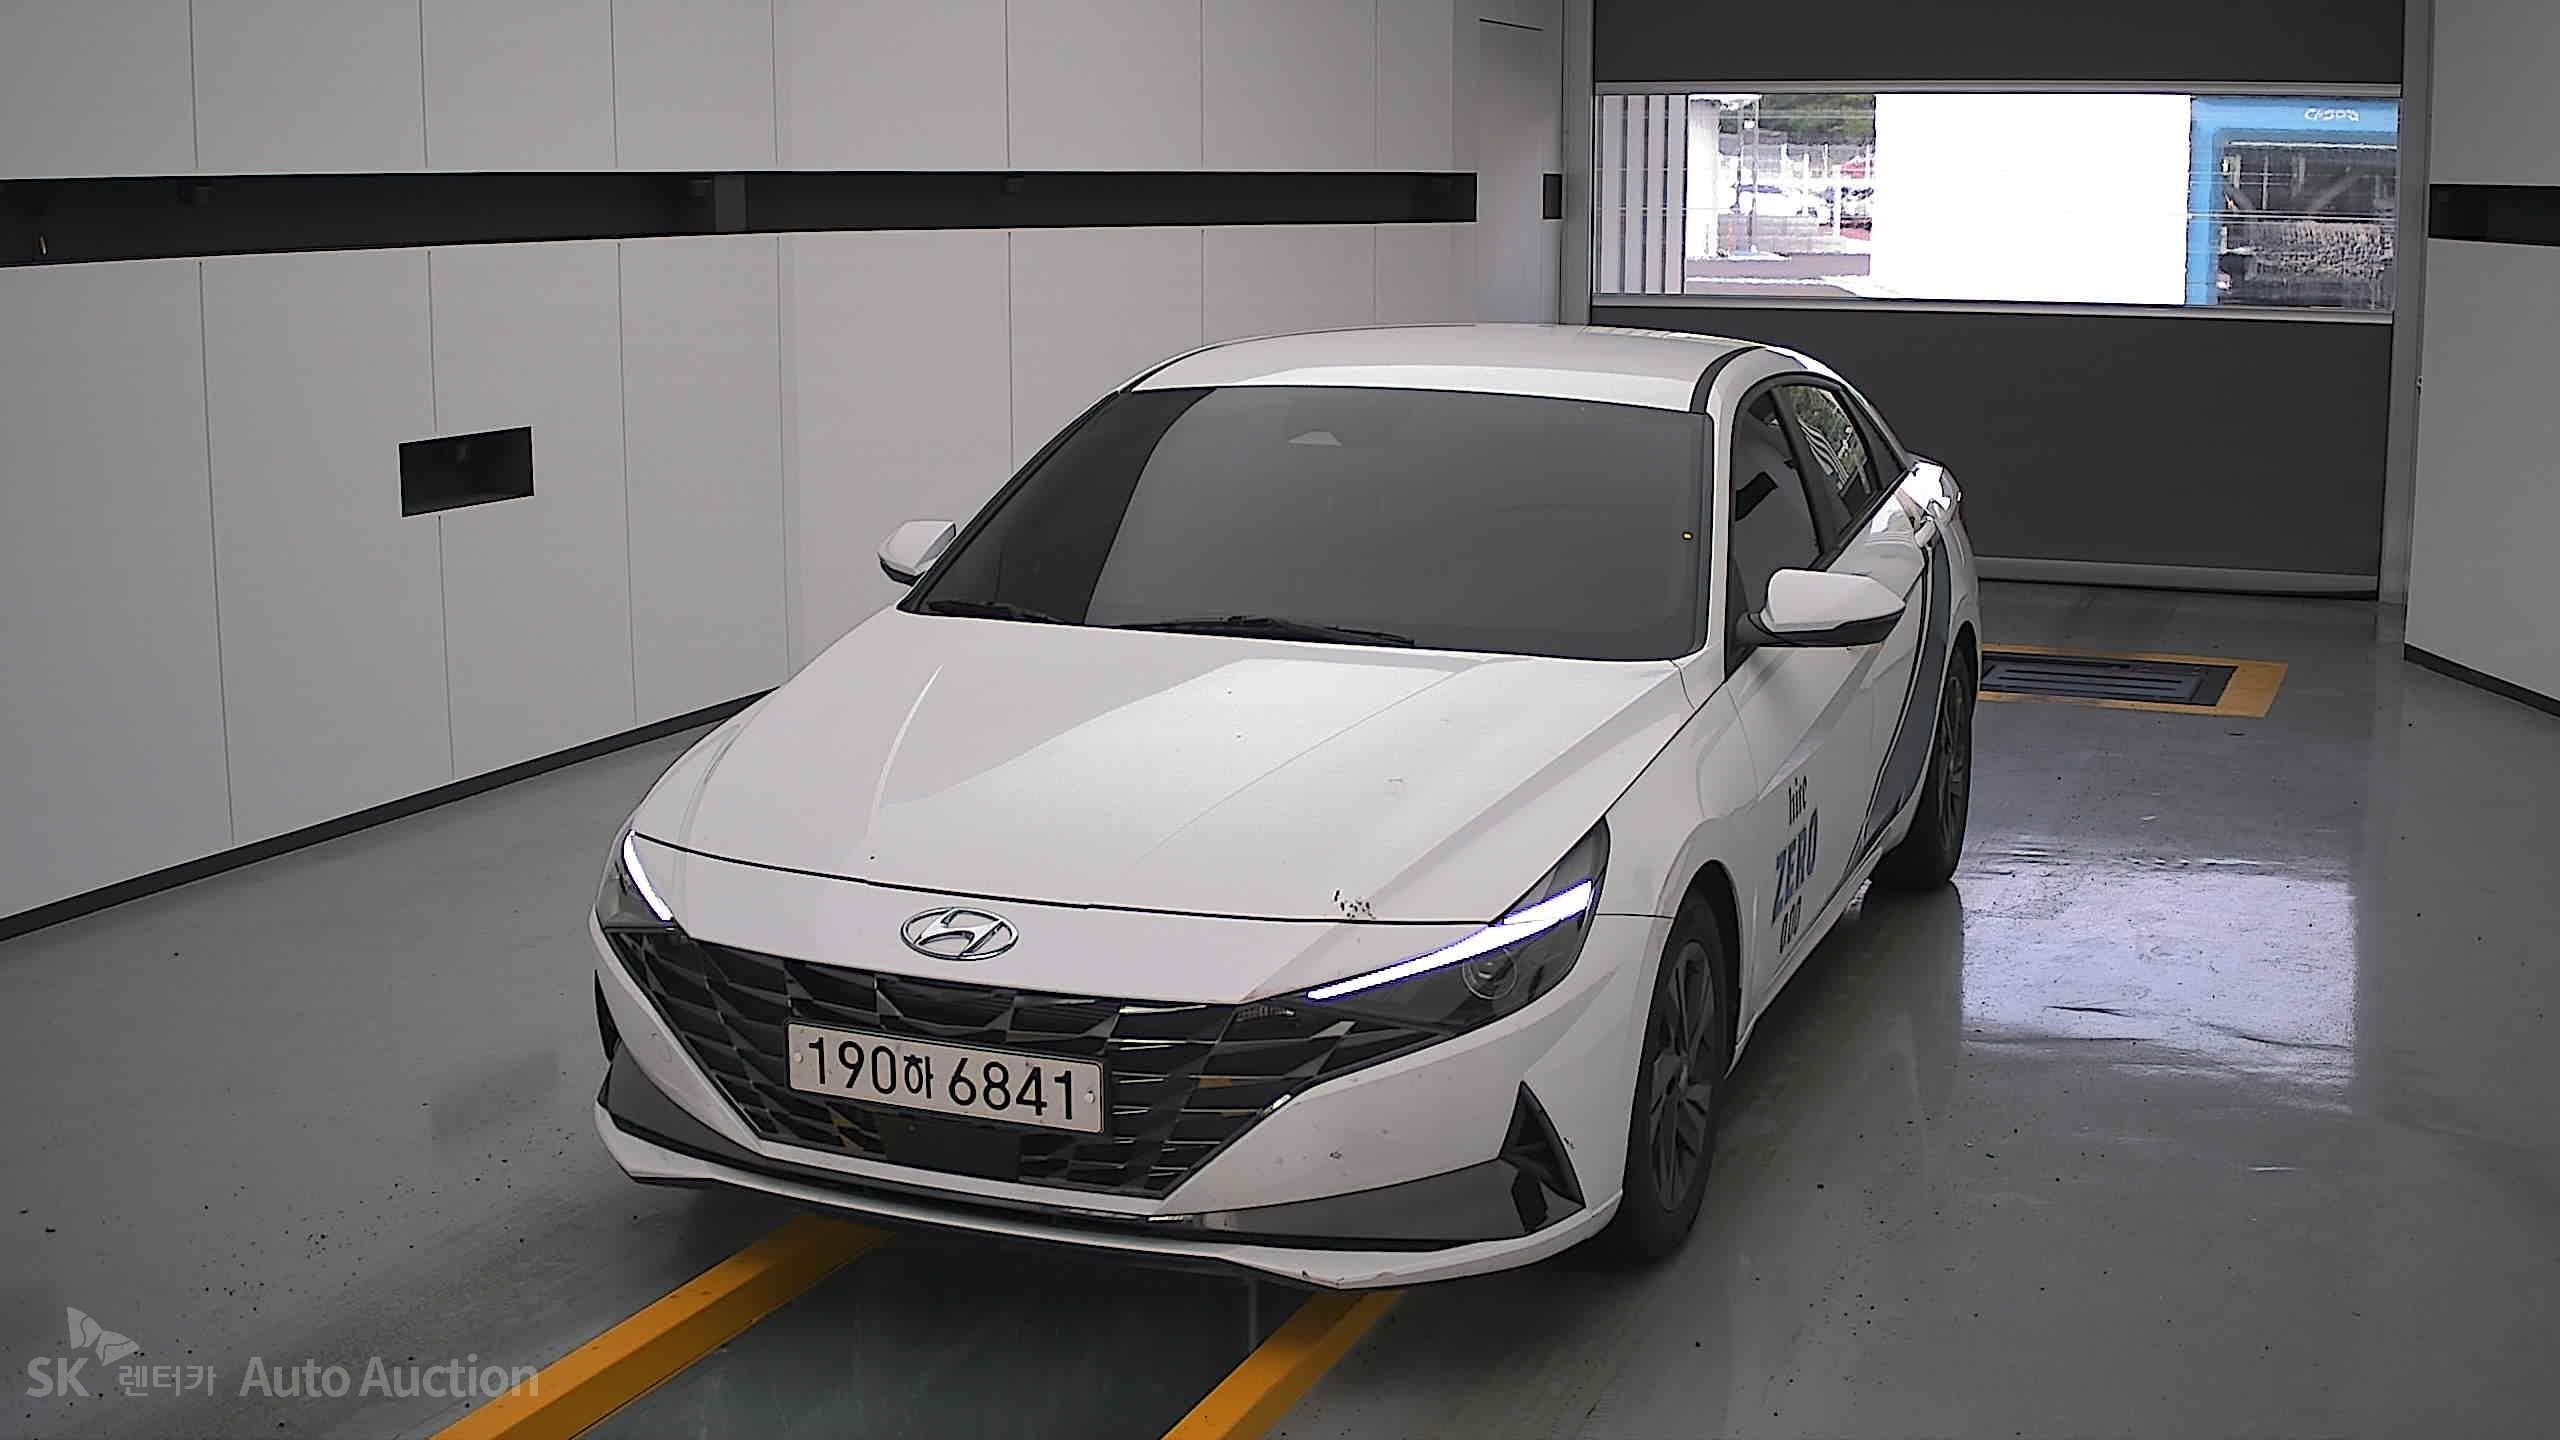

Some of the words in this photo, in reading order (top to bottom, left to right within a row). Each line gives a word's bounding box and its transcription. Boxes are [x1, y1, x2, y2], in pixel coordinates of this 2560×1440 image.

[1772, 808, 1818, 926] ZERO
[808, 1036, 934, 1099] 190하
[949, 1057, 1073, 1120] 6841
